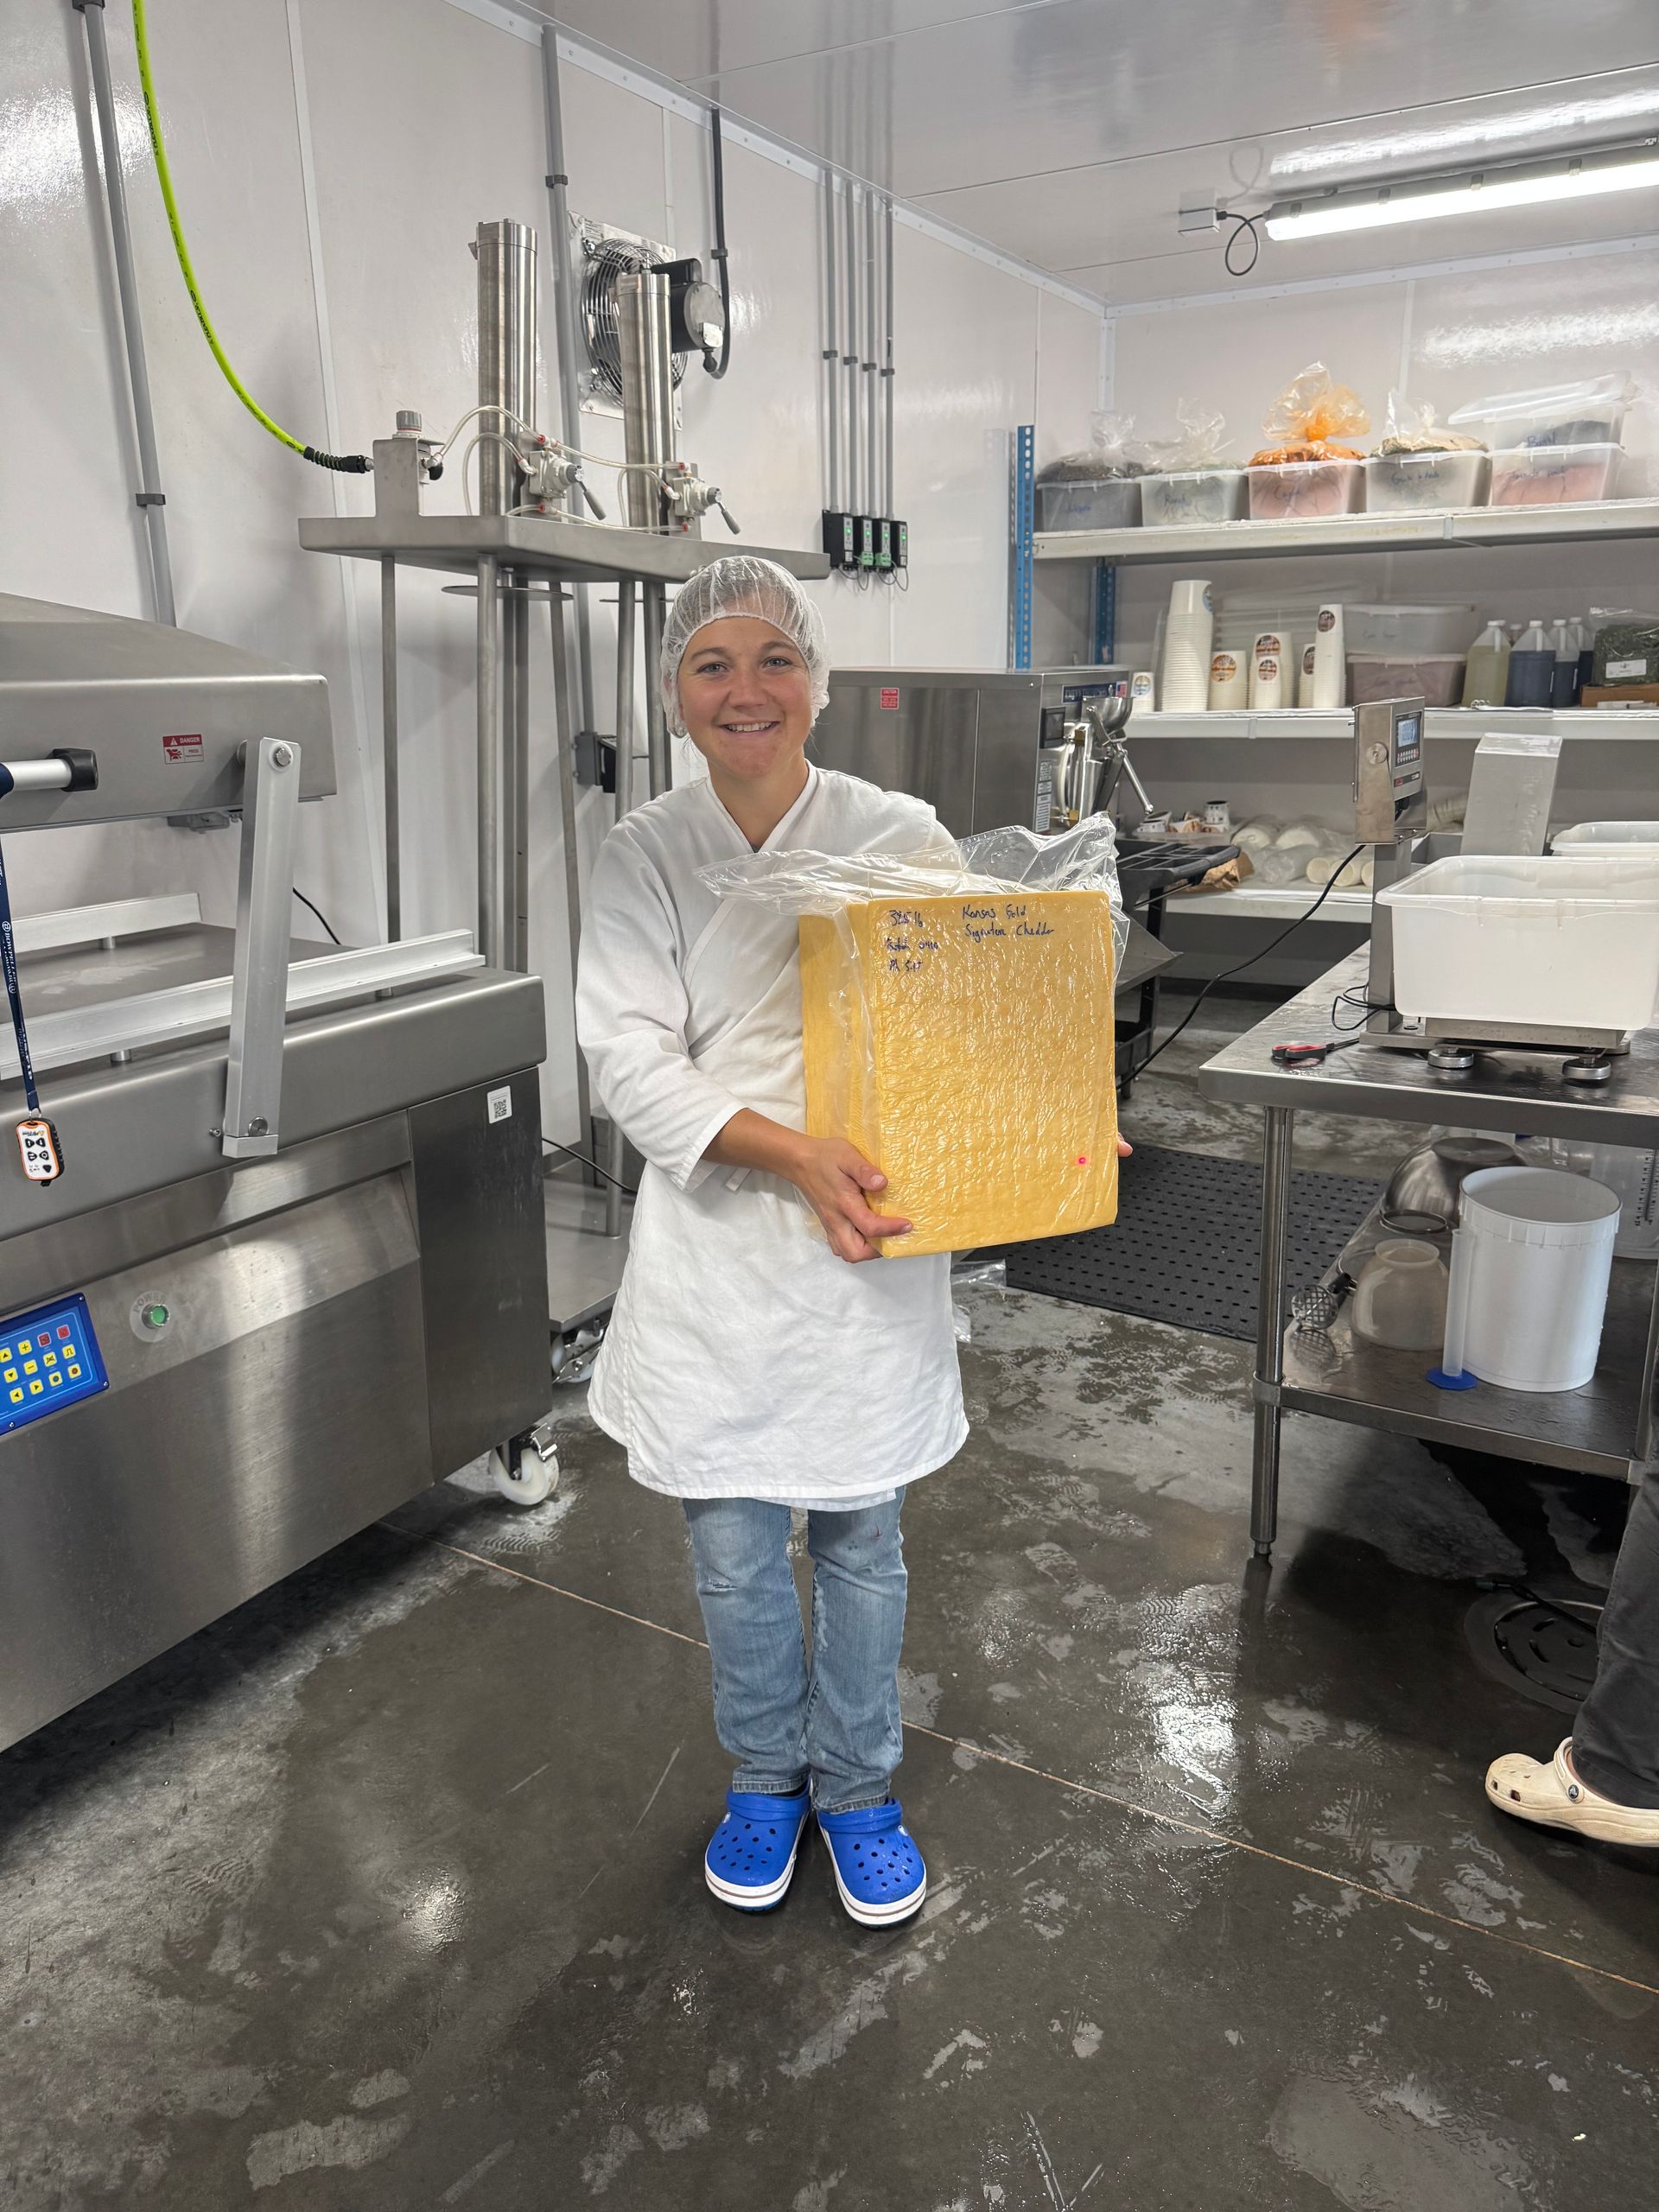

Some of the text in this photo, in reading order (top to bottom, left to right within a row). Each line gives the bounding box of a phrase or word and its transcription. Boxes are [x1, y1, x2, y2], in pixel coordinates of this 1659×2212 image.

[962, 904, 1027, 919] Kansas Gold
[965, 921, 1055, 943] Signature Cheddar
